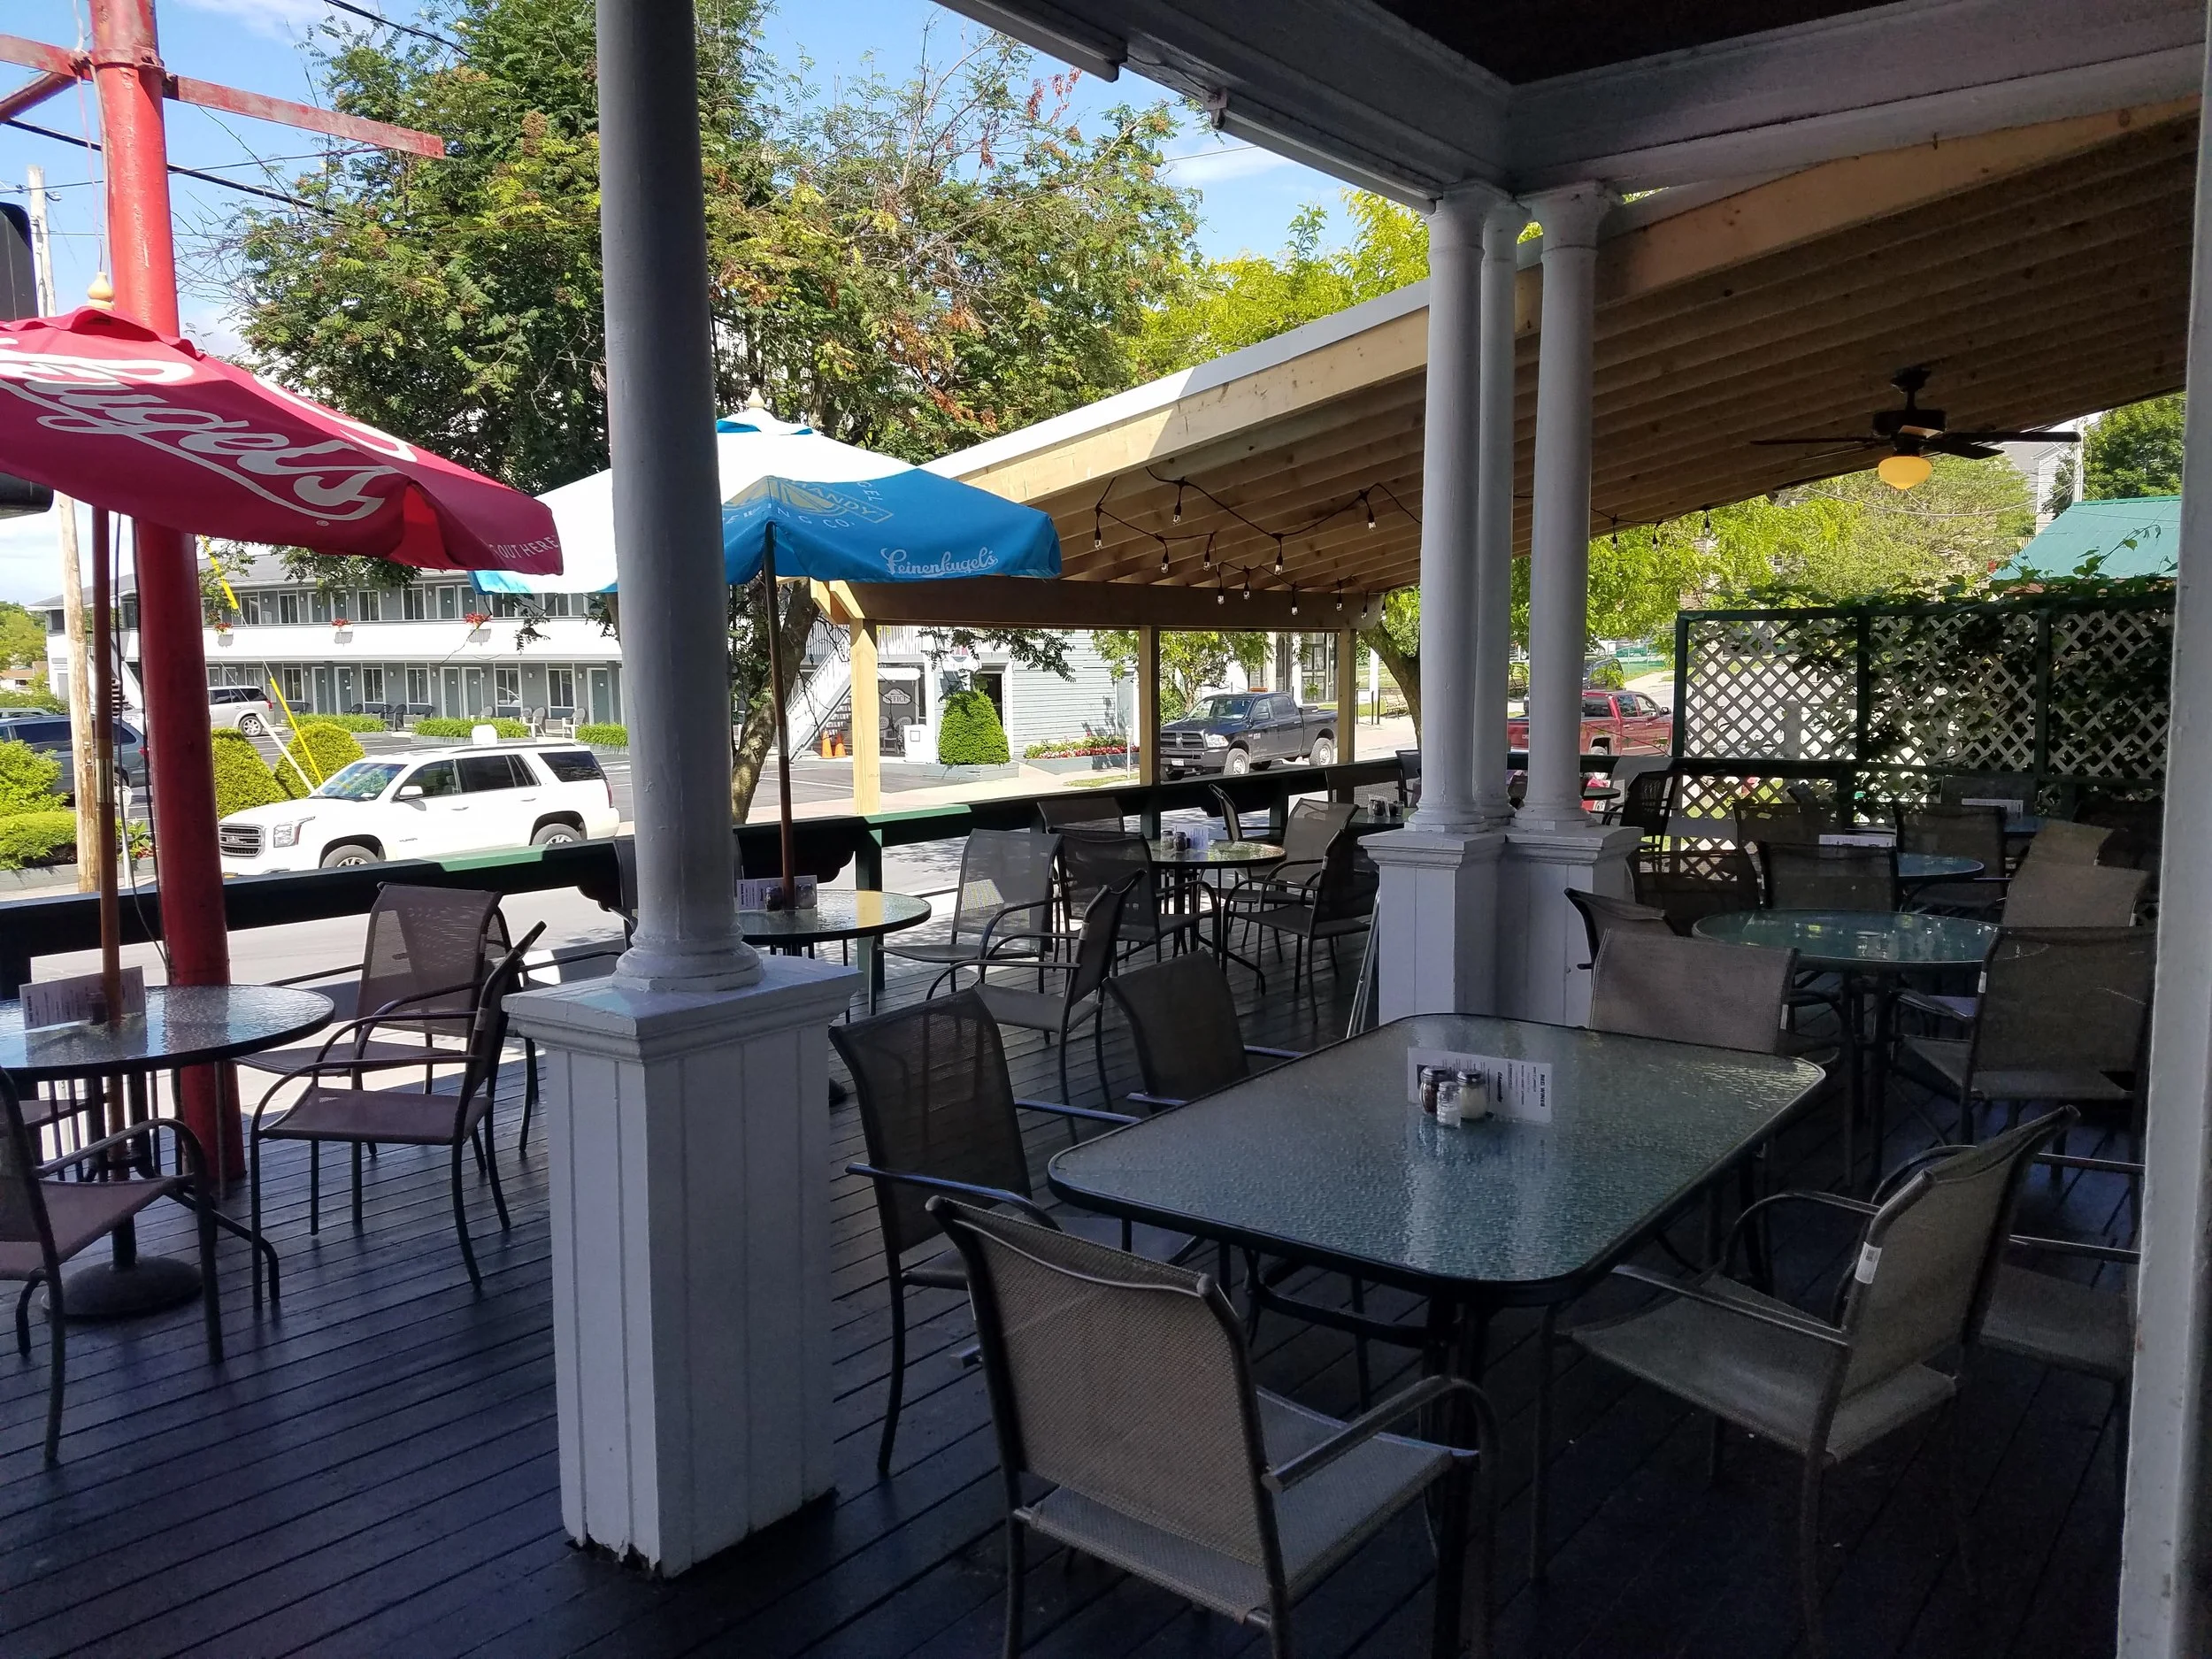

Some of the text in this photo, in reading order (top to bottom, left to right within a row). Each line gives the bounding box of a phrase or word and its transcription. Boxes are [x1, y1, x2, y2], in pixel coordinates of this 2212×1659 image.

[823, 518, 855, 529] CO.
[497, 543, 522, 559] OUT
[519, 535, 558, 557] HERE
[879, 546, 999, 579] Leinenkugel's
